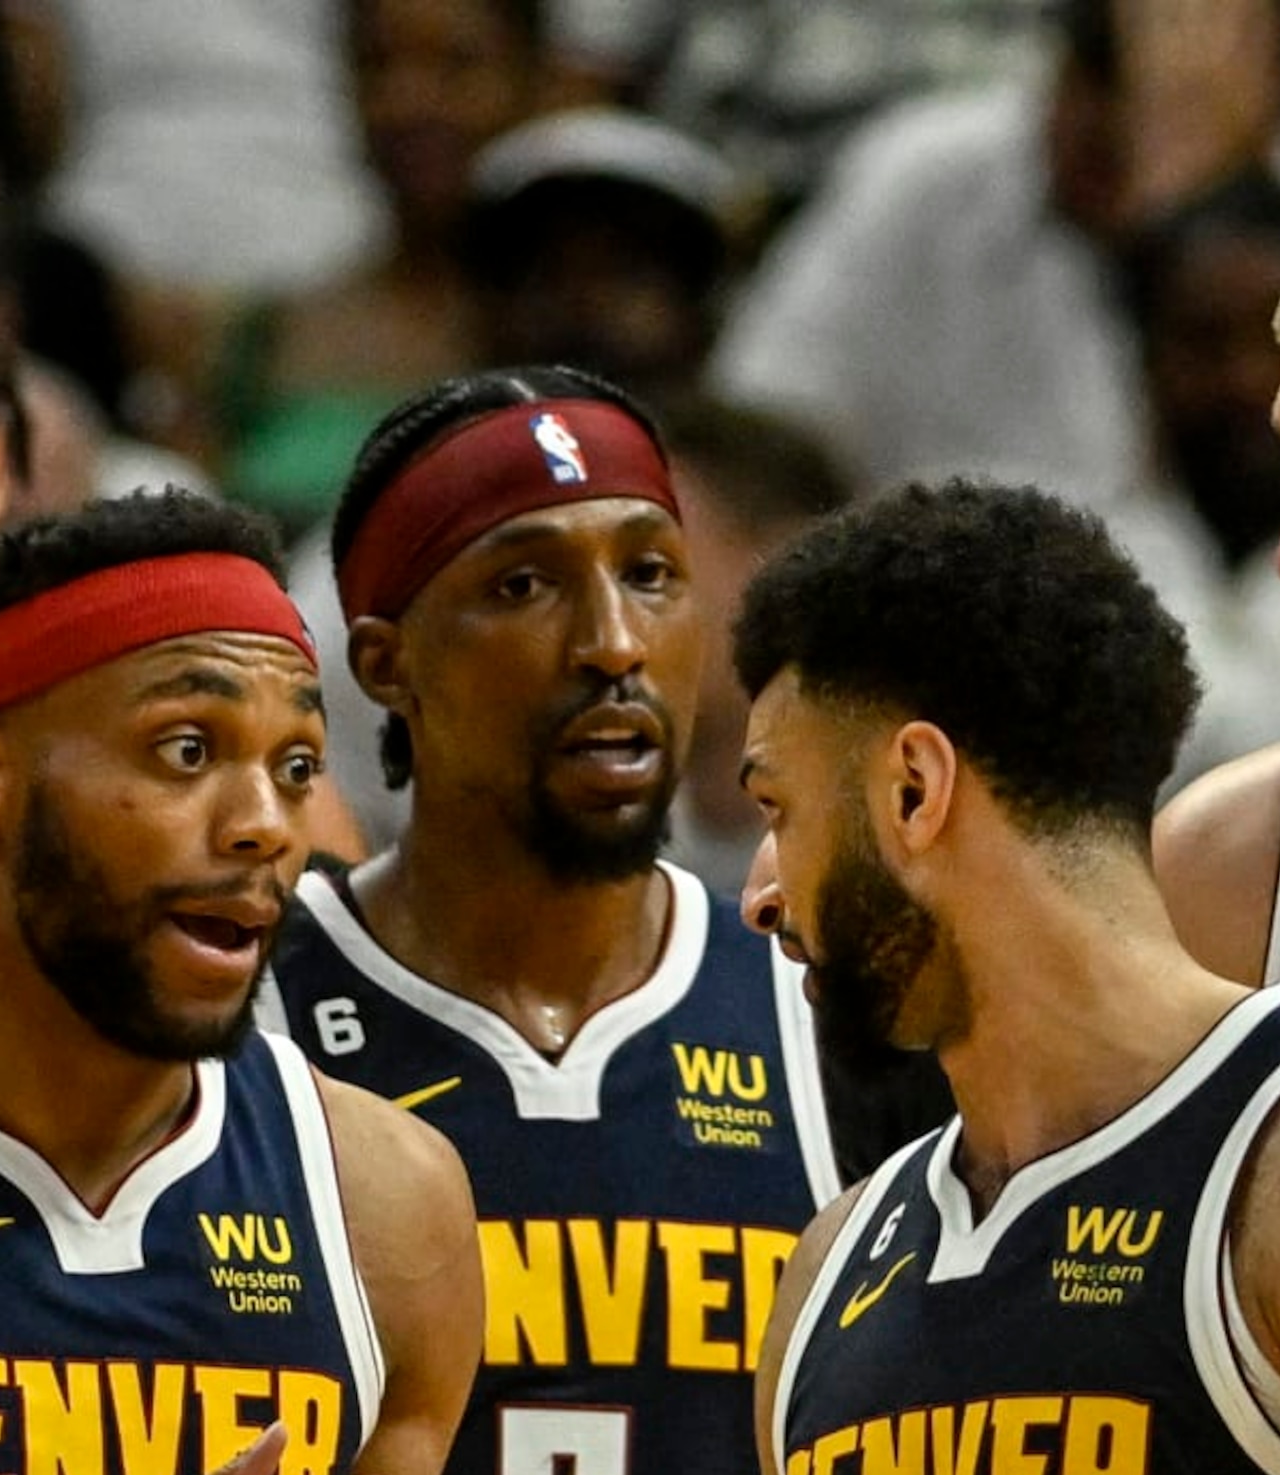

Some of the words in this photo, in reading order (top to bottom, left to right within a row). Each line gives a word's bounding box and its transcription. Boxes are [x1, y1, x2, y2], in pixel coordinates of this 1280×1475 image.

[314, 997, 365, 1056] 6
[671, 1043, 767, 1101] WU
[676, 1097, 773, 1128] Western
[693, 1121, 762, 1148] Union
[198, 1212, 292, 1265] WU
[869, 1201, 906, 1260] 6
[1066, 1205, 1164, 1257] WU
[209, 1265, 301, 1292] Western
[1051, 1259, 1145, 1283] Western
[228, 1289, 293, 1314] Union
[1059, 1280, 1124, 1305] Union
